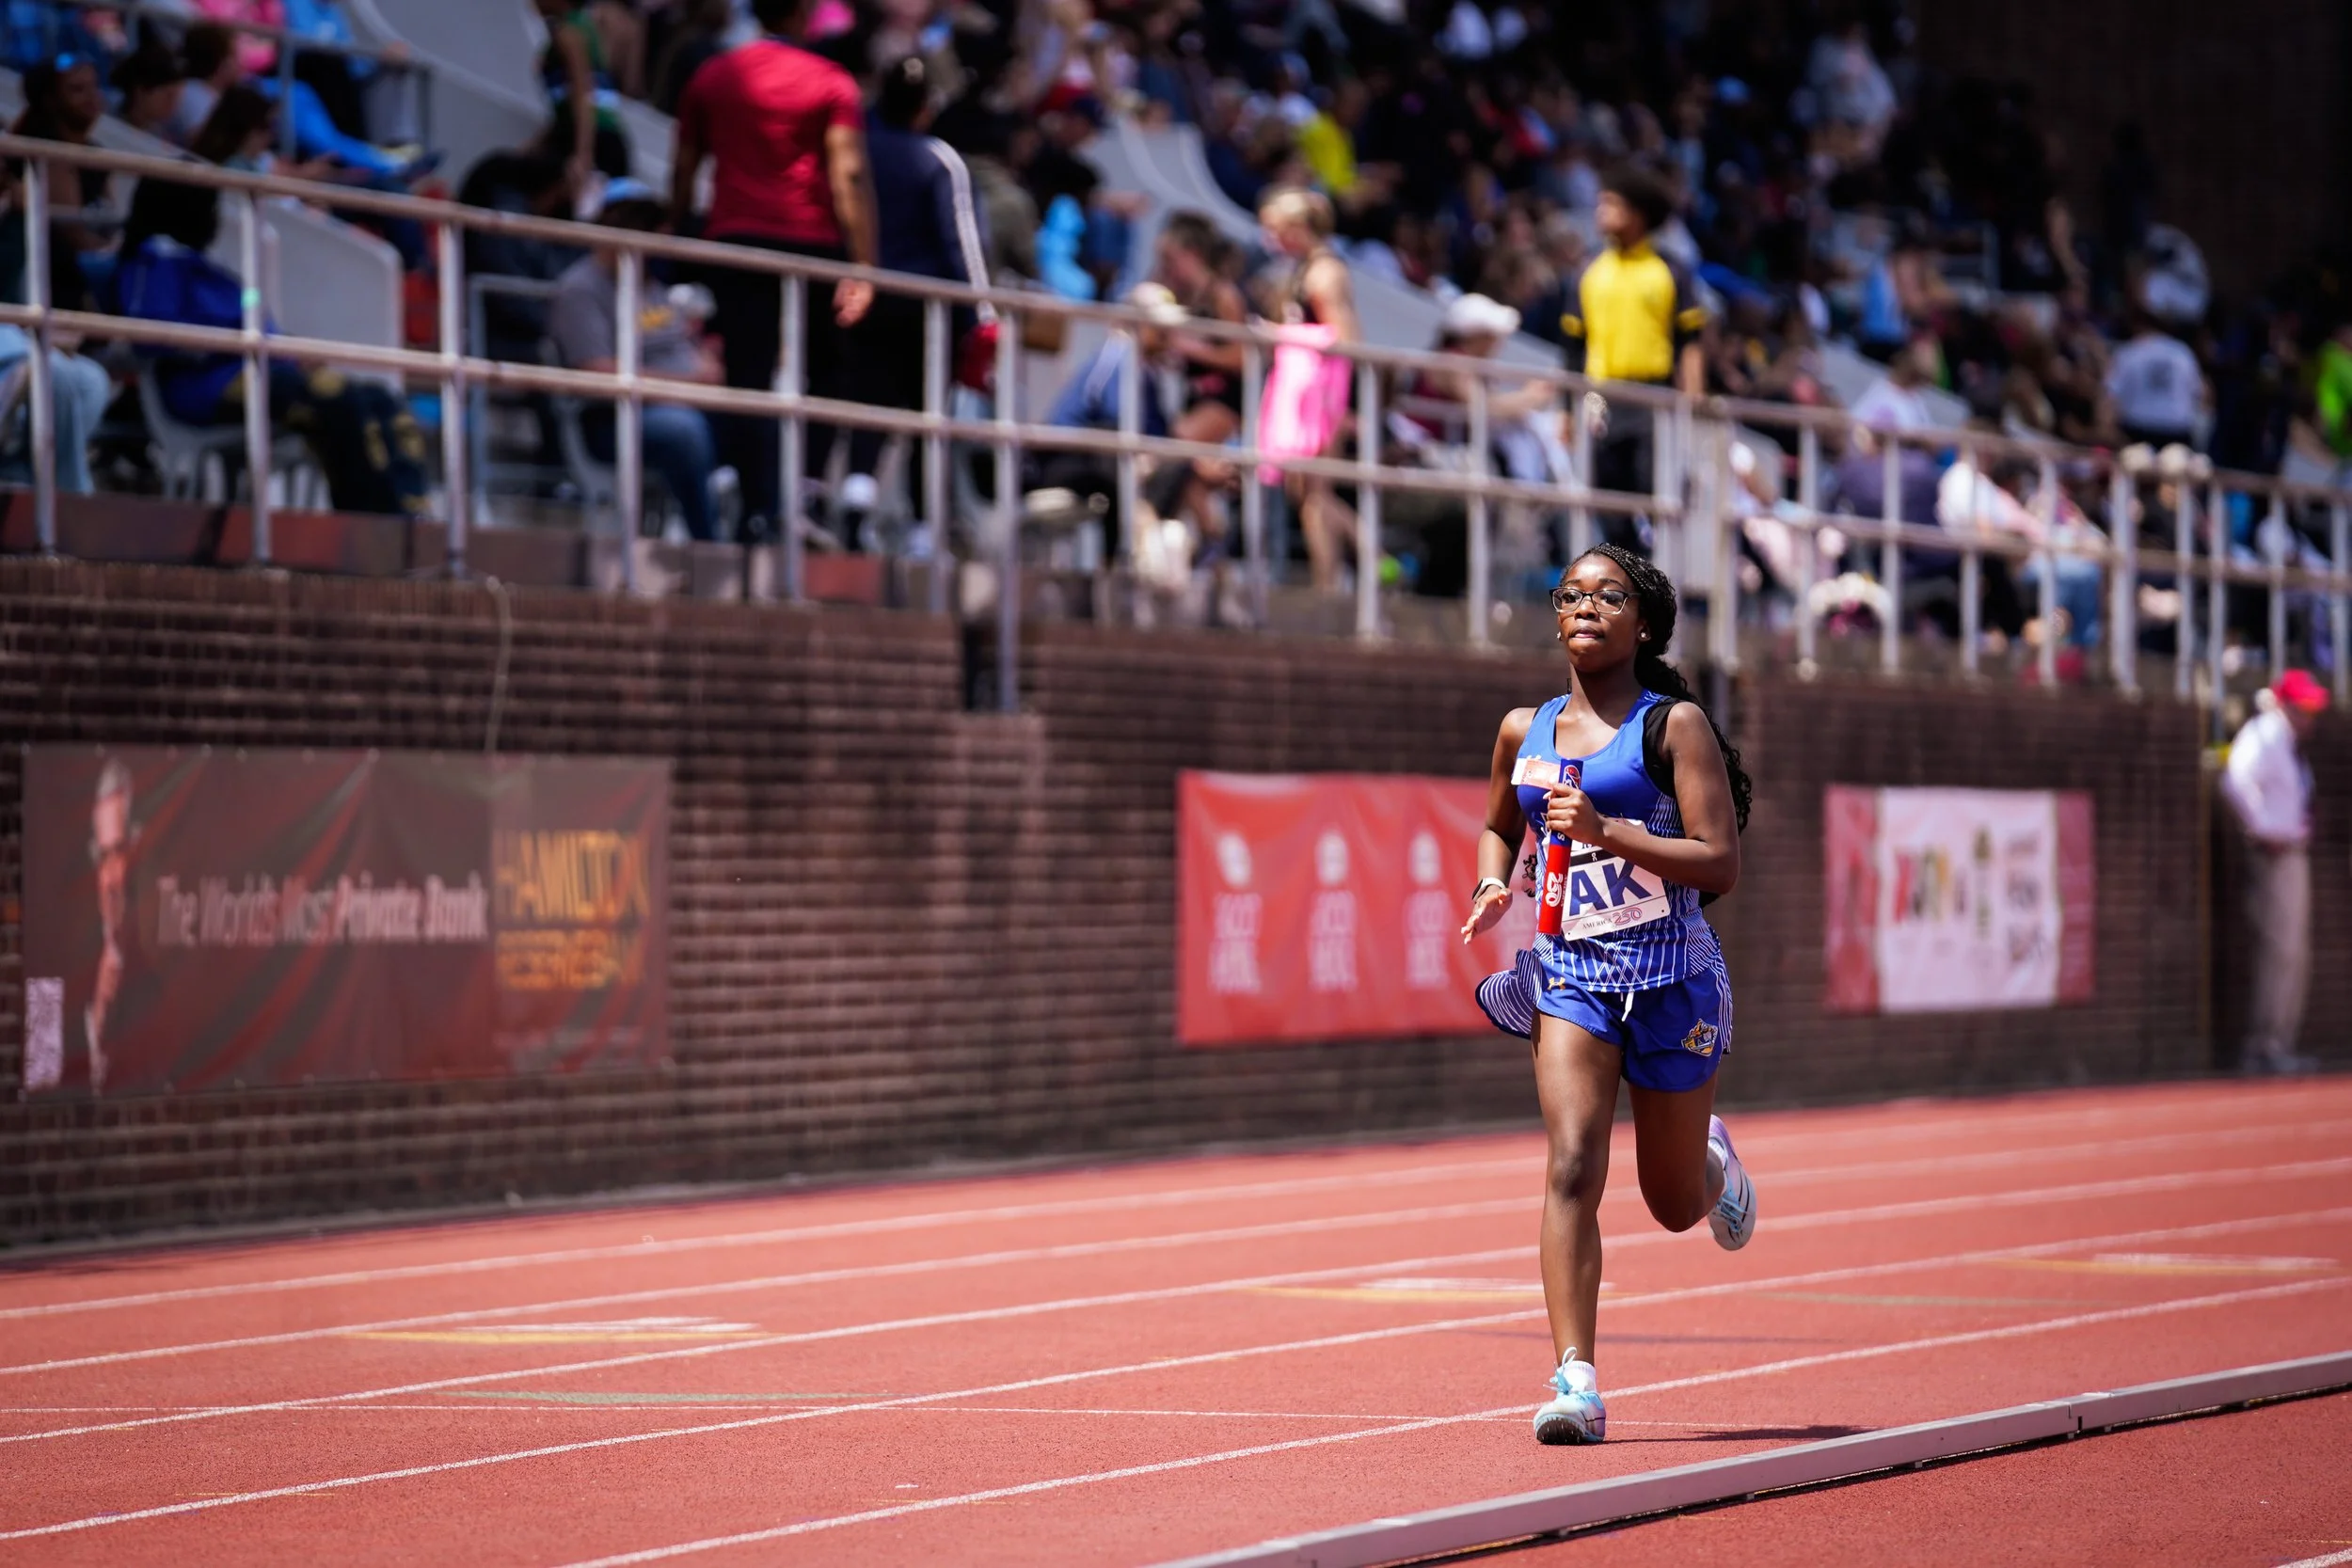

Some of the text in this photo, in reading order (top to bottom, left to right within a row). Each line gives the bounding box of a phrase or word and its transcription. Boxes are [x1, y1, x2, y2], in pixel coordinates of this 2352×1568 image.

[156, 872, 199, 948] The
[199, 871, 276, 947] World's
[334, 869, 421, 942] Private
[425, 869, 488, 940] Bank
[1545, 871, 1564, 908] 250
[1569, 860, 1652, 917] AK
[1582, 907, 1643, 930] AMERICA 250
